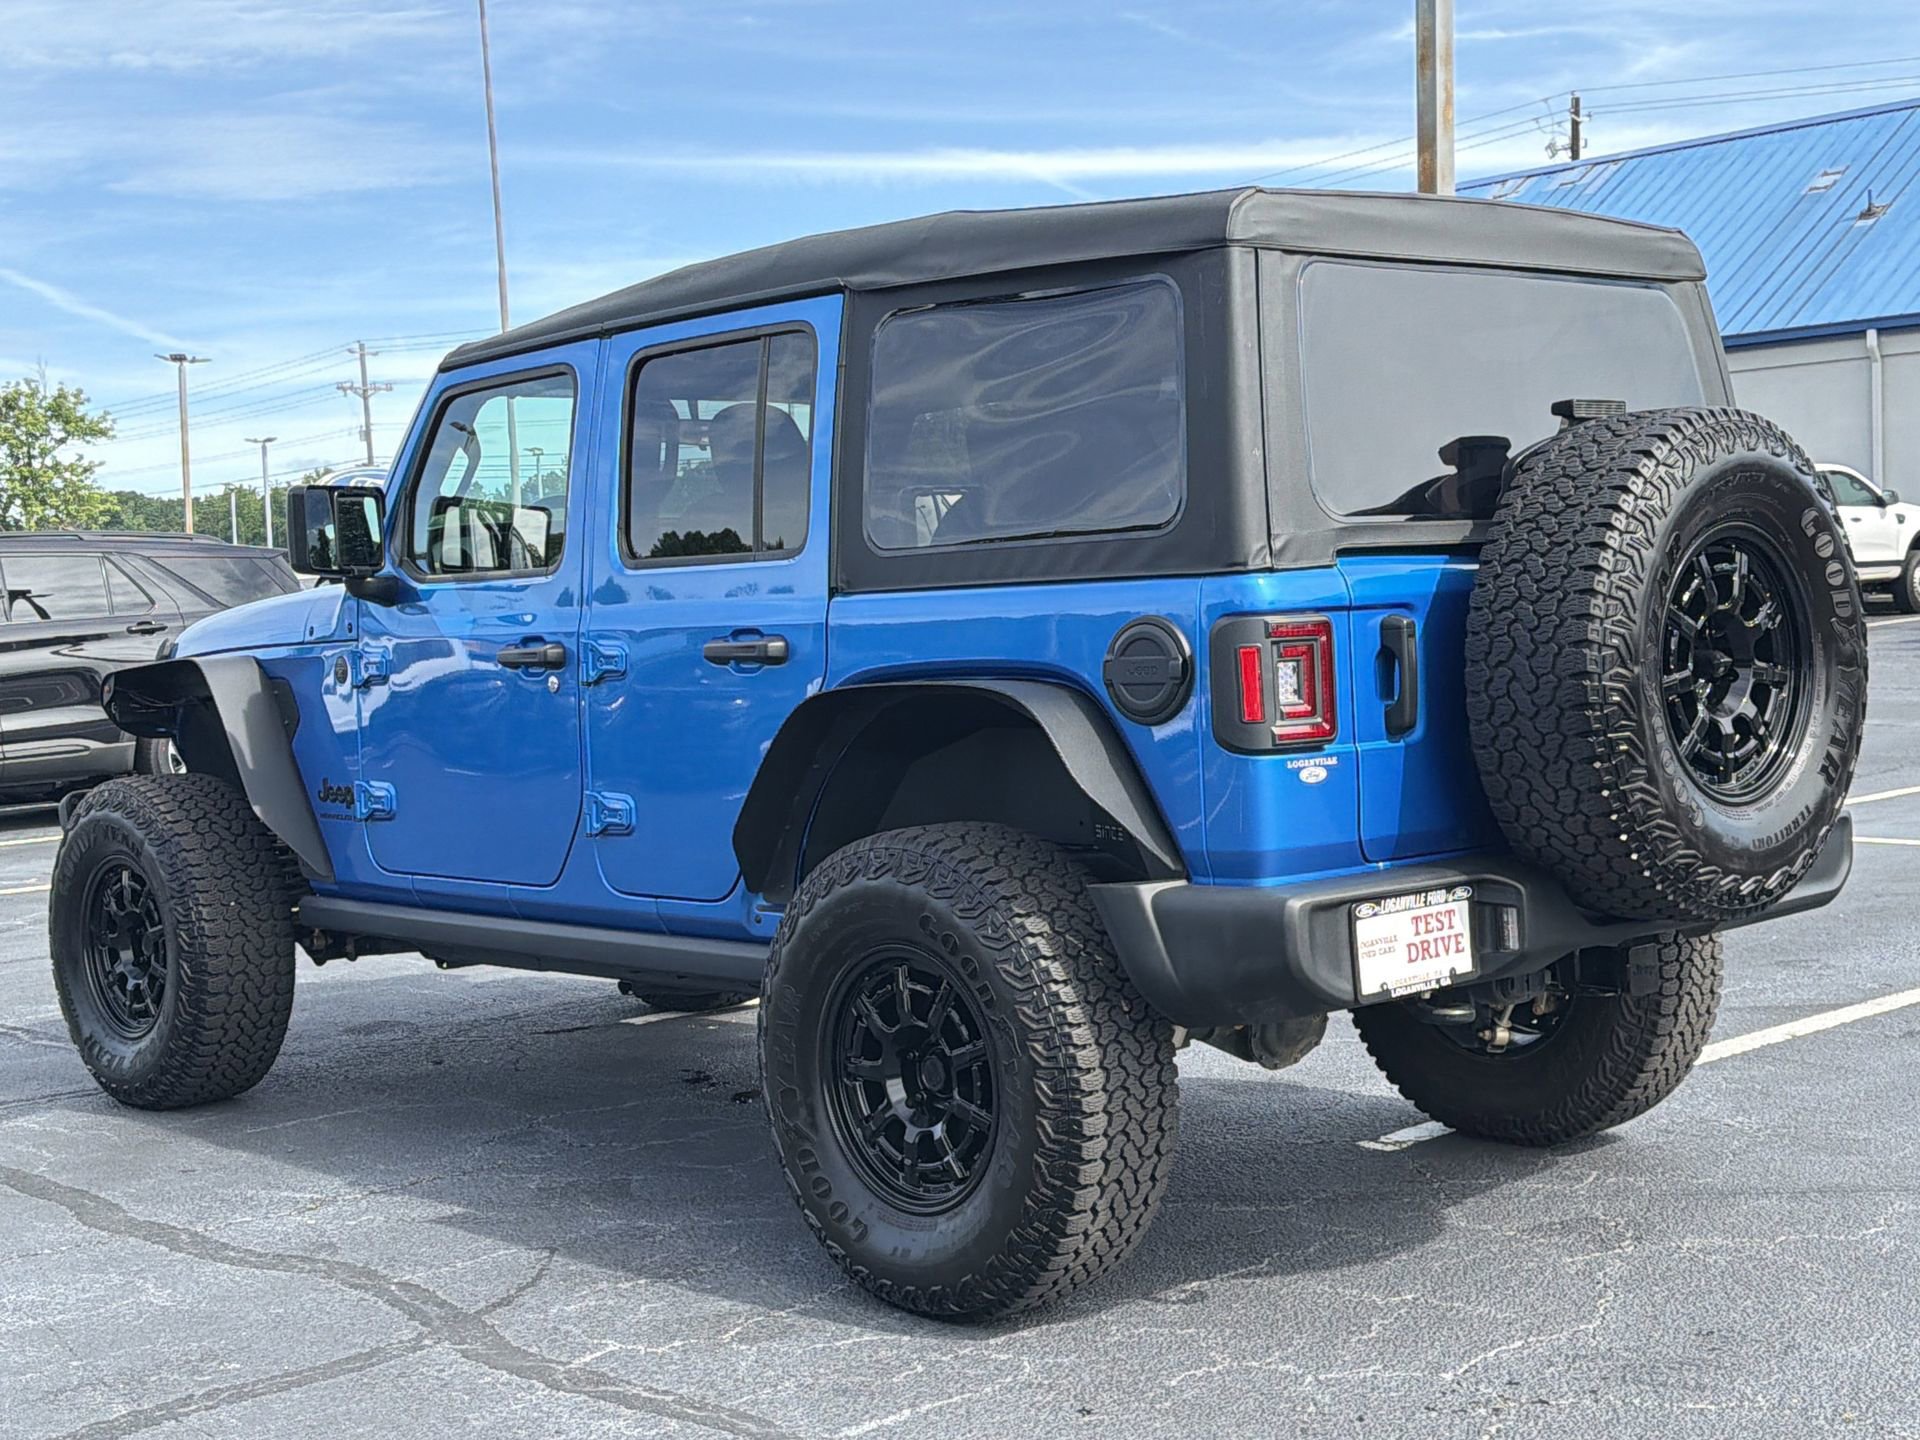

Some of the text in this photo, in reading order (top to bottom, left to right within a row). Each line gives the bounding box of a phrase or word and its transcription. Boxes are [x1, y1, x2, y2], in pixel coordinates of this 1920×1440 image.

[1800, 507, 1860, 787] GOODYEAR
[1286, 756, 1338, 769] LOGANVILLE
[318, 777, 355, 809] Jeep
[1751, 804, 1813, 851] TERRITORY
[1380, 889, 1446, 913] LOGANVILLE FORD
[1411, 908, 1456, 937] TEST
[1406, 932, 1465, 964] DRIVE
